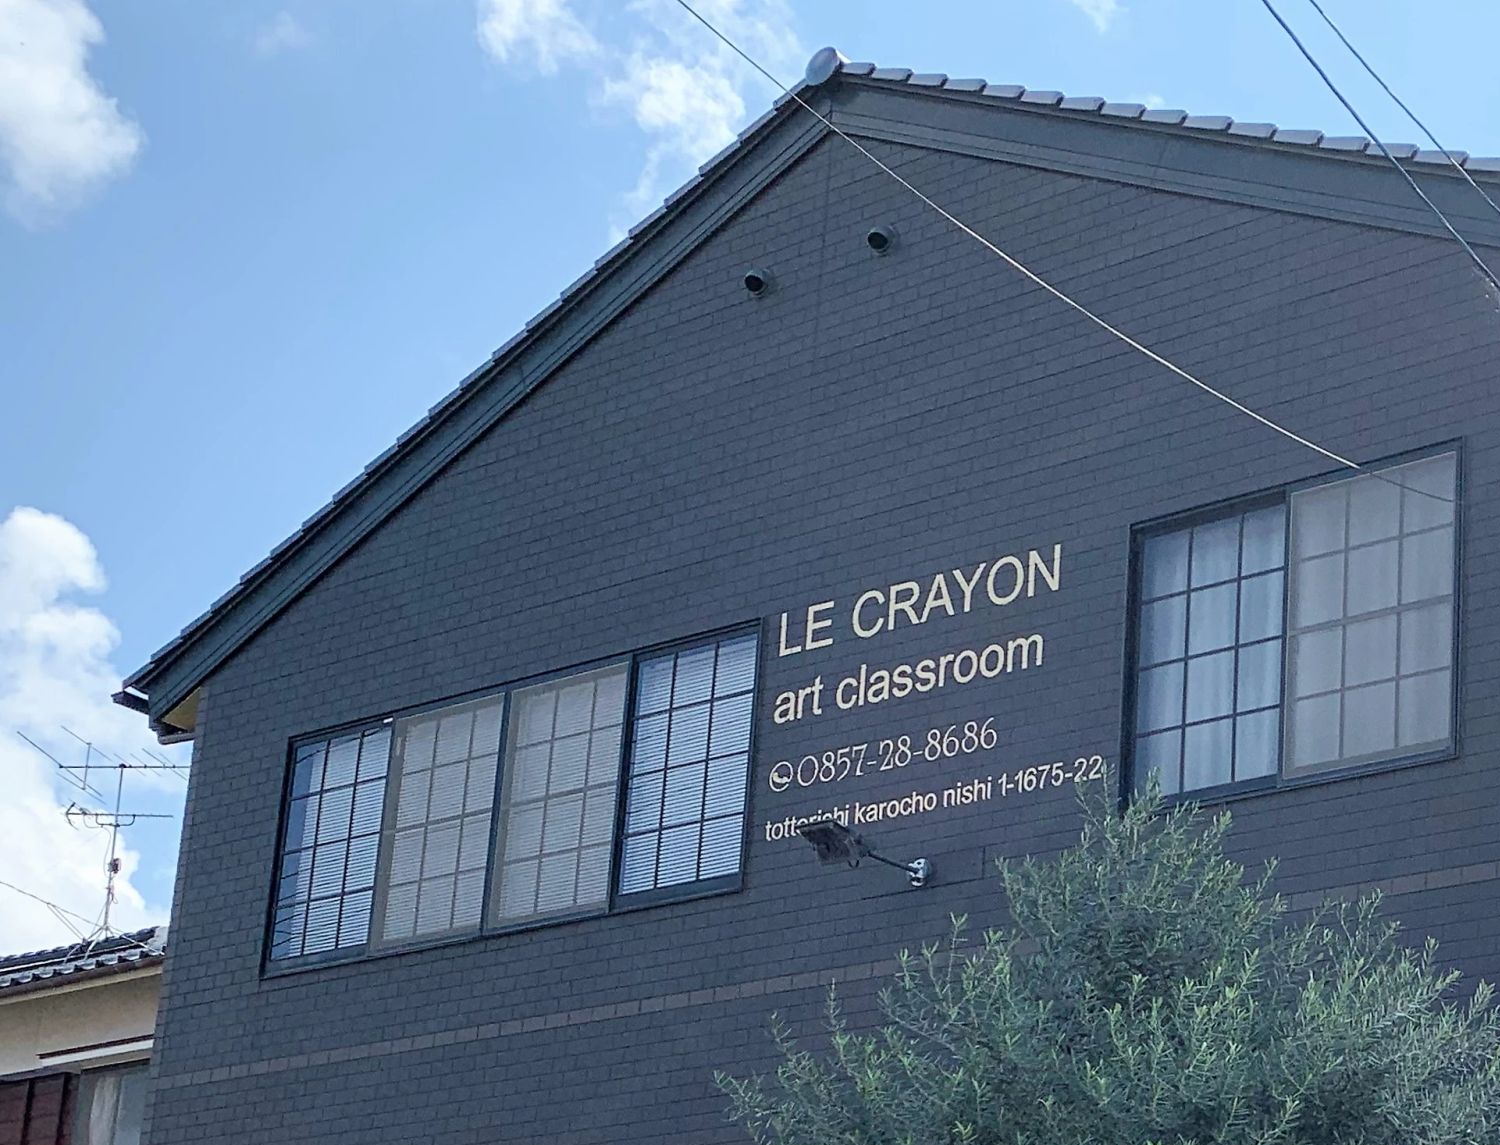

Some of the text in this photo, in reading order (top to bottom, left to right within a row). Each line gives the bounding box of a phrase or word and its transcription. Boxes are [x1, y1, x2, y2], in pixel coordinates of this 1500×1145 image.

[779, 544, 1061, 657] LE CRAYON
[773, 634, 1044, 724] art classroom
[797, 717, 998, 787] 0857-28-8686
[855, 791, 938, 825] karocho
[943, 776, 992, 808] nishi
[998, 755, 1103, 797] 1-1675-22
